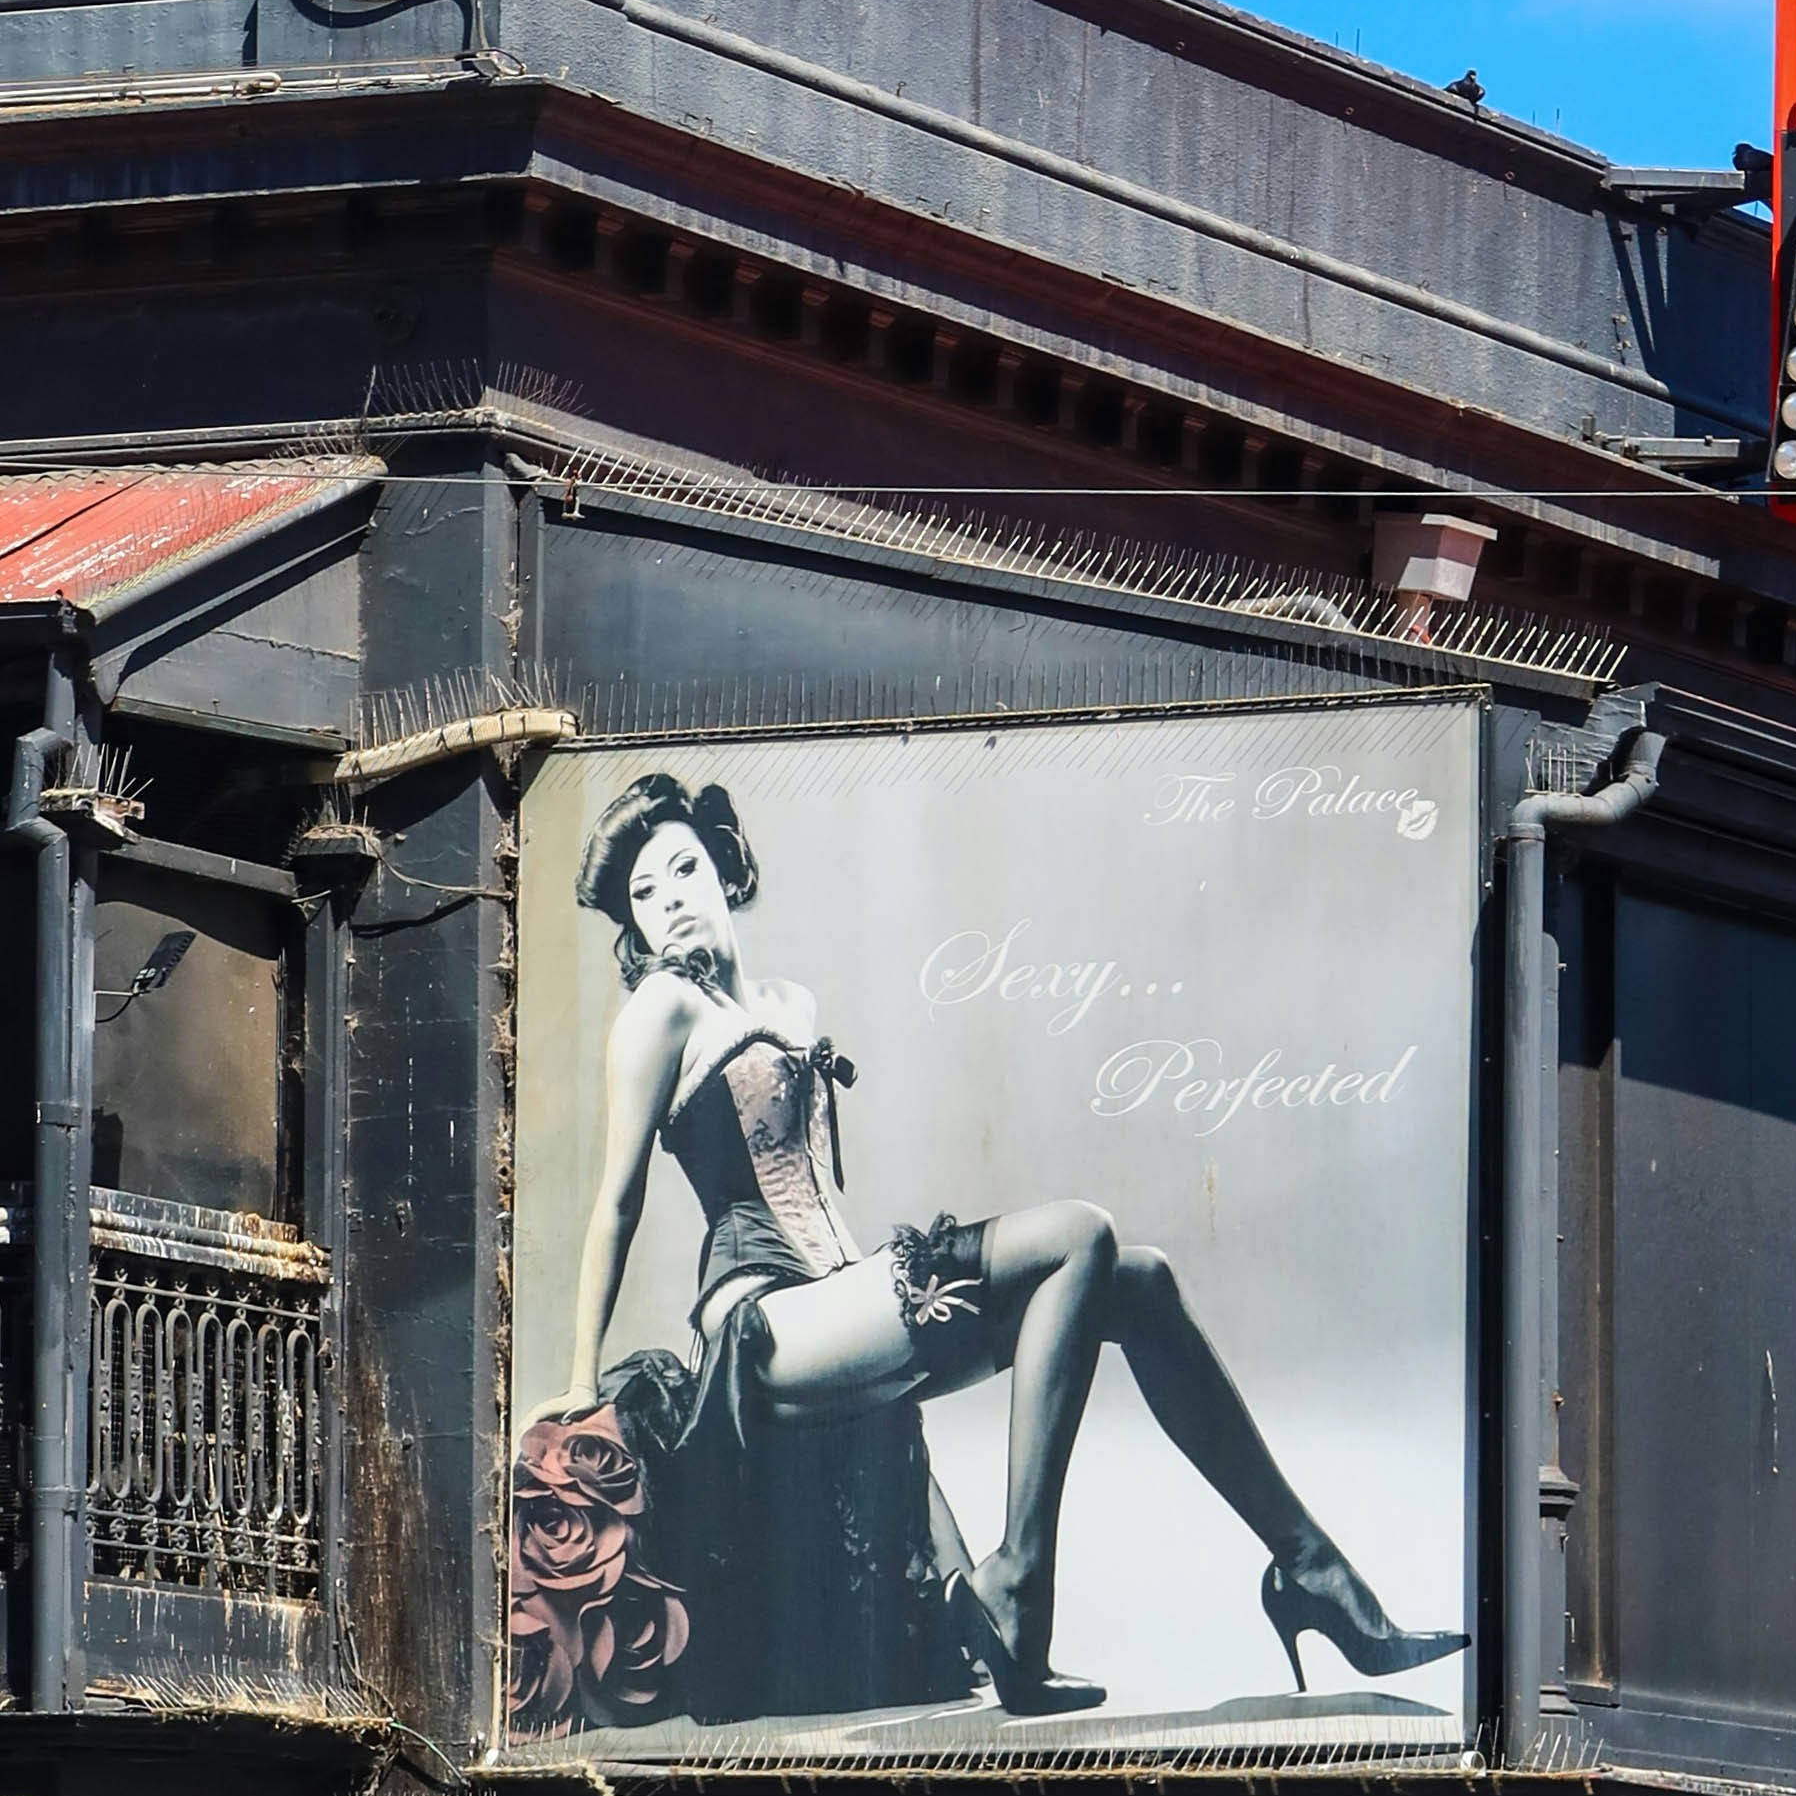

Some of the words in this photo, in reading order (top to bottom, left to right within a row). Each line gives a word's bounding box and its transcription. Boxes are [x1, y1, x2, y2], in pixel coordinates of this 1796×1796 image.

[1144, 771, 1237, 826] The
[1251, 765, 1419, 821] Palace
[919, 918, 1184, 1036] Sexy...
[1091, 1038, 1418, 1137] Perfected
